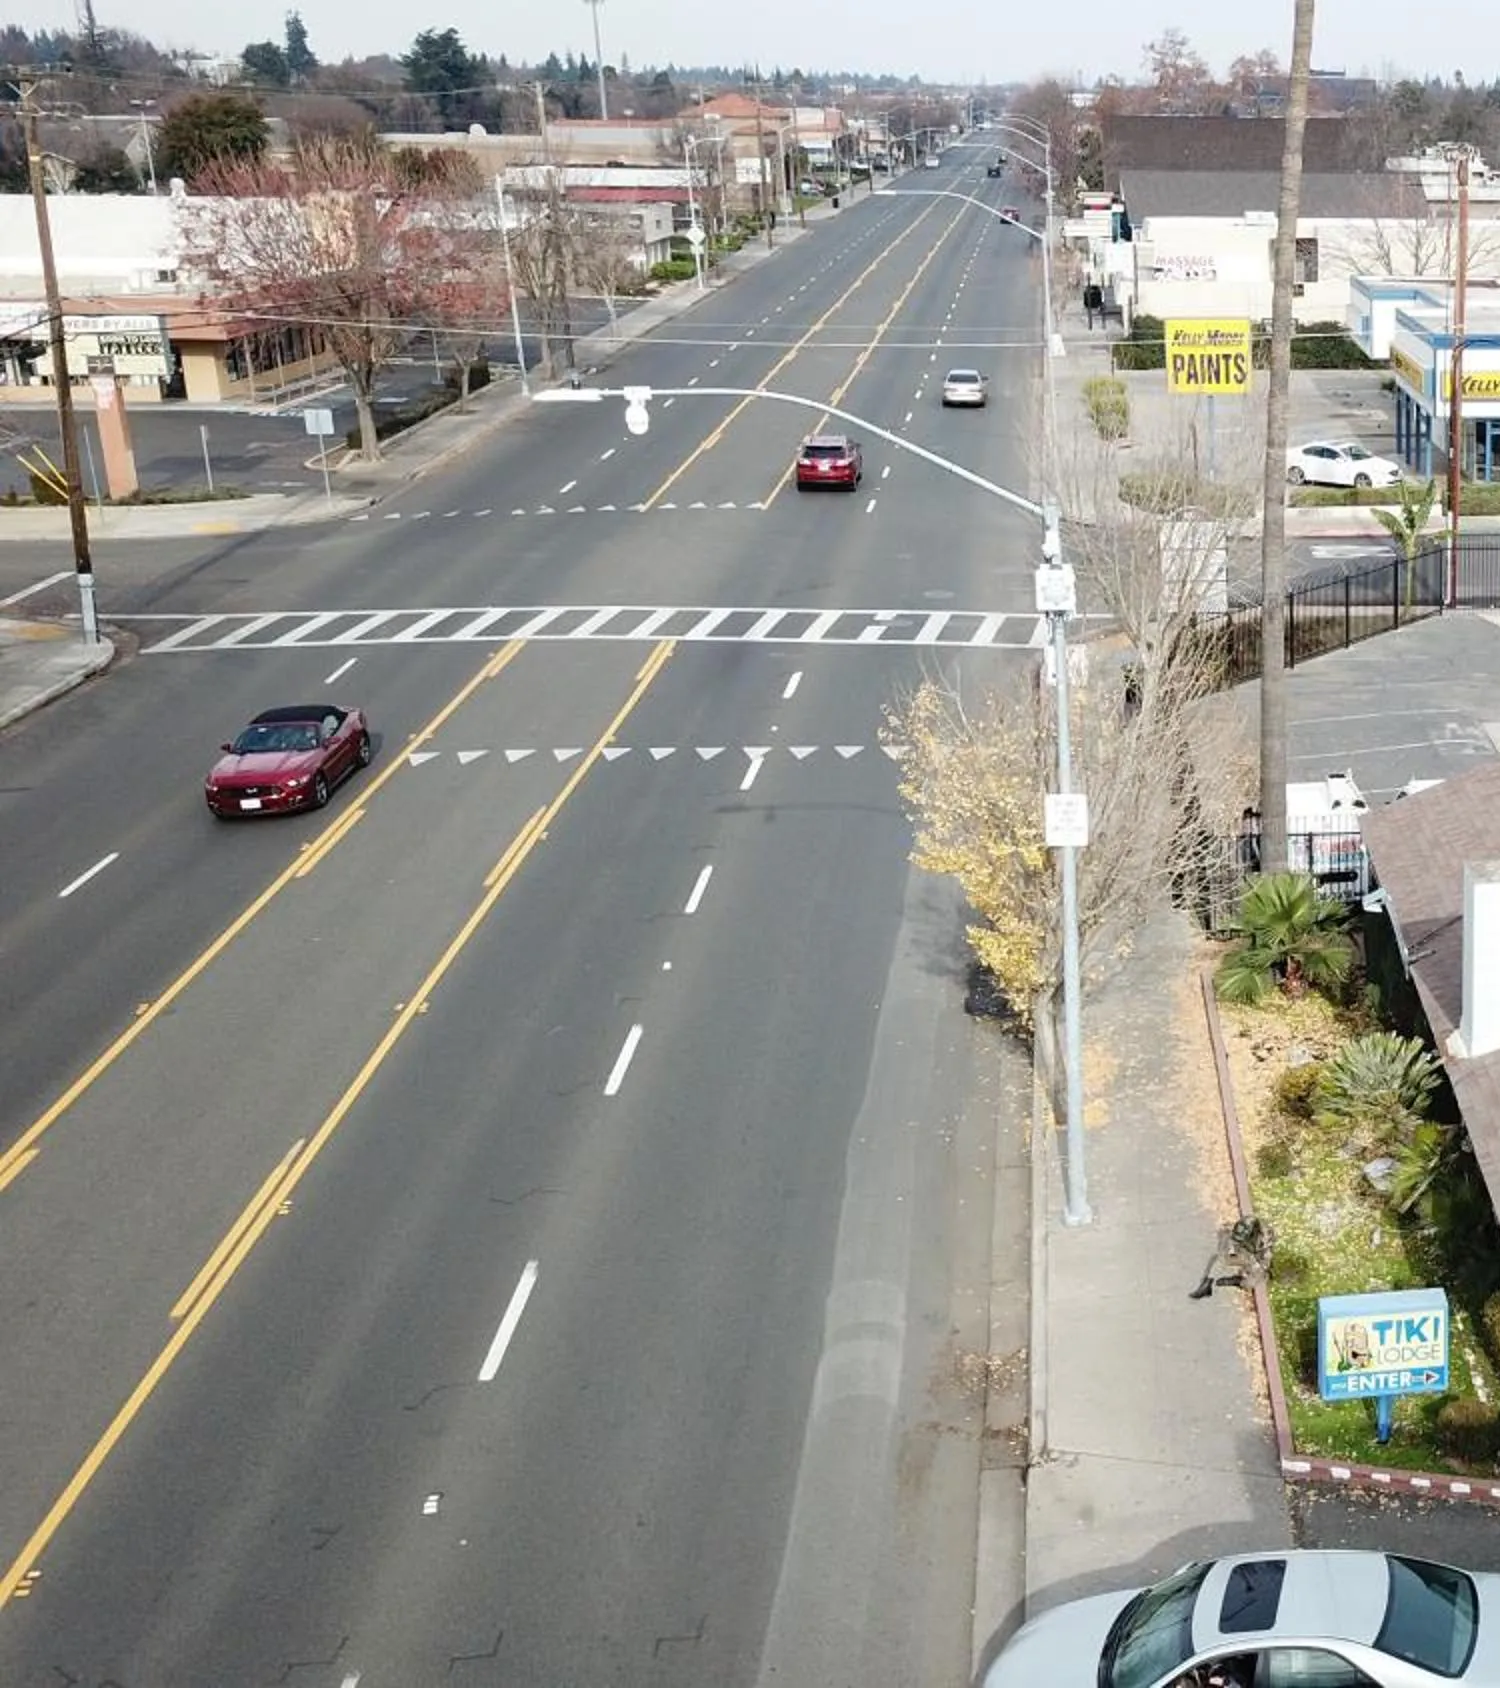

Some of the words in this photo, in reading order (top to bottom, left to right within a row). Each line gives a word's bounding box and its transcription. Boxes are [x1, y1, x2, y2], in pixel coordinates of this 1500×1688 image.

[1172, 352, 1248, 385] PAINTS
[1371, 1315, 1440, 1346] TIKI
[1377, 1343, 1441, 1366] LODGE
[1346, 1371, 1412, 1393] ENTER
